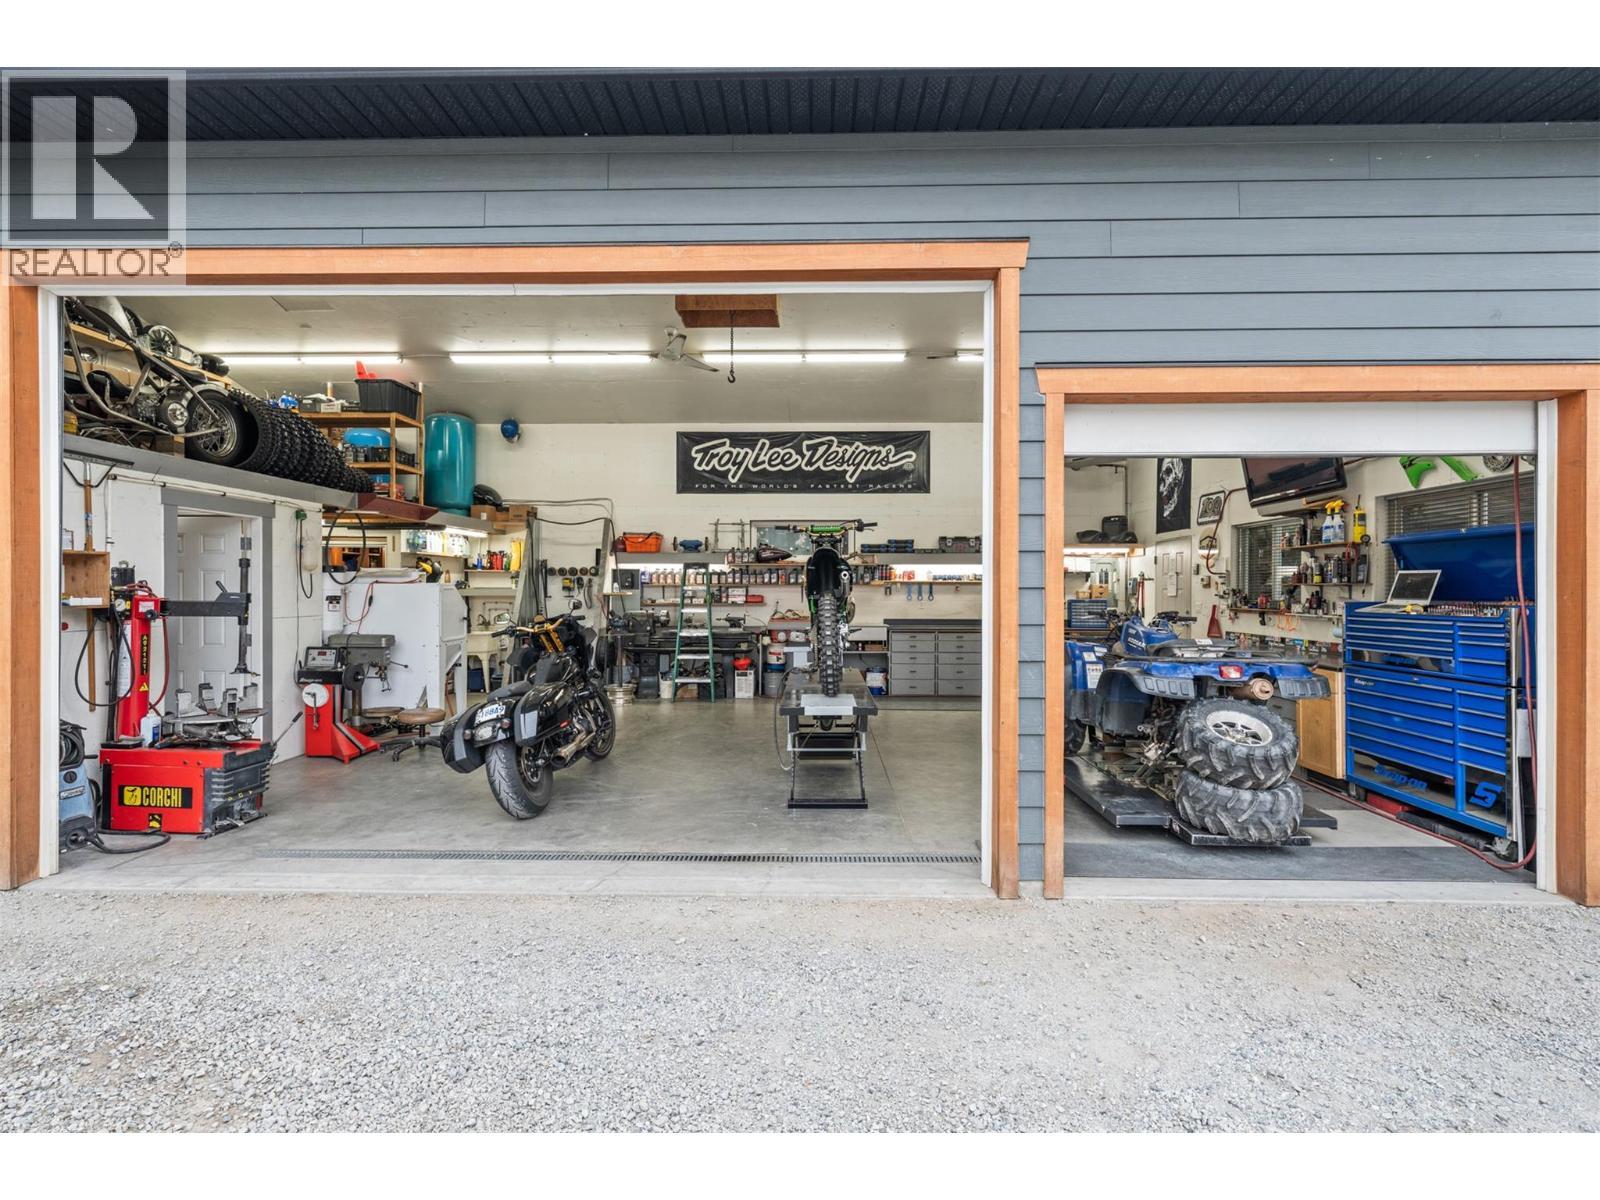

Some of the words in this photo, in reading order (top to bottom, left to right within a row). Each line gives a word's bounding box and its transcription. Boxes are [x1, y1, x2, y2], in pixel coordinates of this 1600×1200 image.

[692, 438, 752, 483] Troy
[750, 438, 800, 472] Lee
[801, 436, 917, 483] Designs
[142, 786, 182, 808] CORGHI
